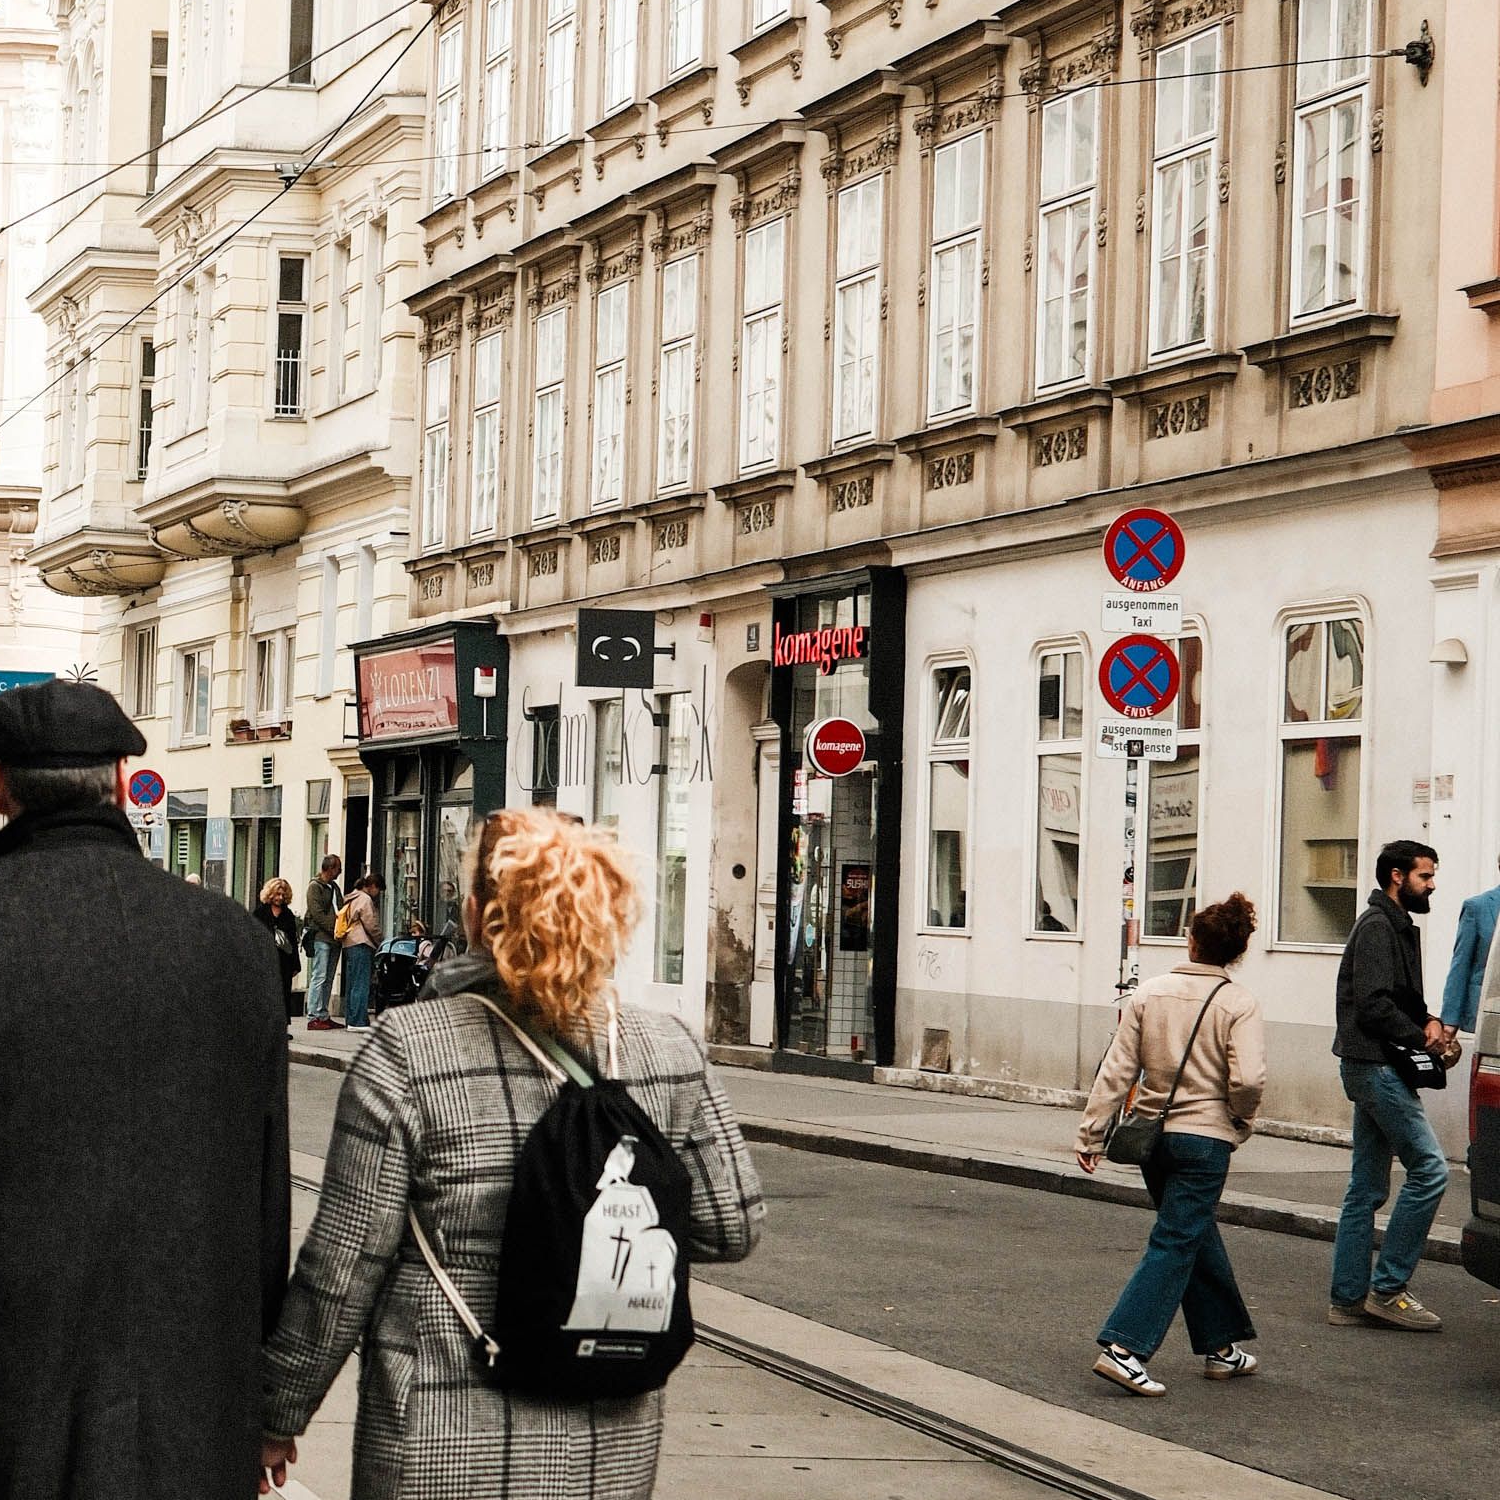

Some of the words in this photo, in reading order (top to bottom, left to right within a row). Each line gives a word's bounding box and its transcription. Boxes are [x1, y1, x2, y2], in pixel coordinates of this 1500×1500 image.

[1120, 576, 1166, 591] ANFANG
[1106, 599, 1179, 612] ausgenommen
[1132, 616, 1152, 627] Taxi
[774, 622, 864, 676] komagene
[383, 666, 442, 708] LORENZI
[1123, 705, 1154, 717] ENDE
[1102, 725, 1172, 736] ausgenommen
[816, 738, 861, 755] komagene
[602, 1203, 643, 1218] HEAST
